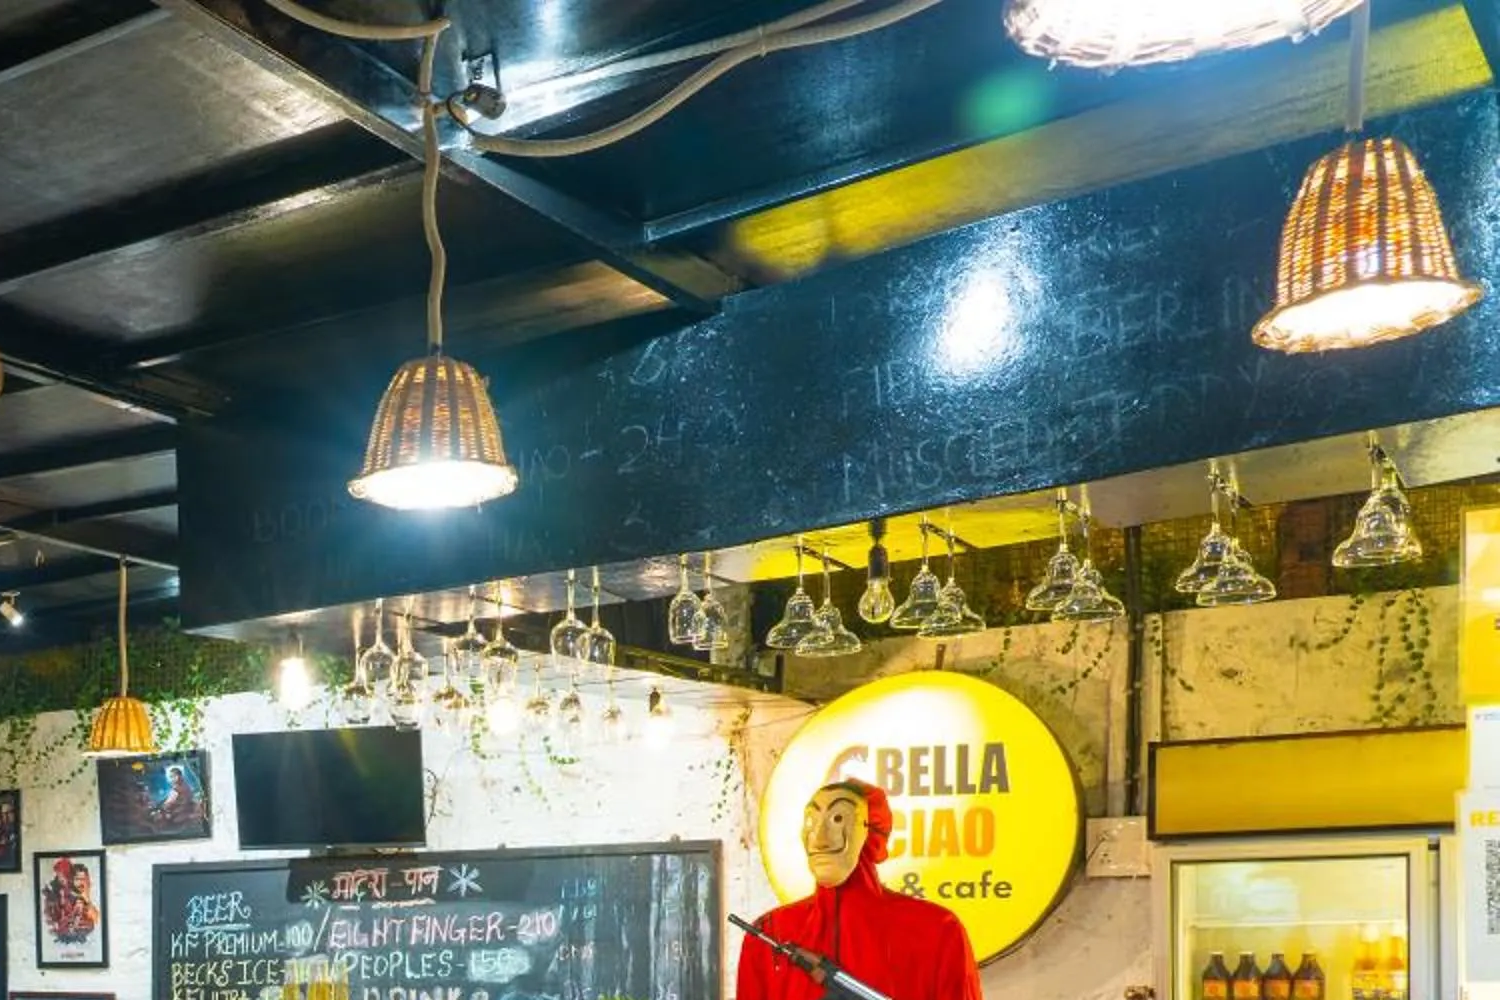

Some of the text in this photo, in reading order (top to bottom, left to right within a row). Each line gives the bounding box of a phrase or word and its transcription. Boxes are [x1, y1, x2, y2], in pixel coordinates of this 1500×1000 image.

[876, 741, 1010, 797] BELLA
[888, 806, 997, 859] CIAO
[902, 870, 1013, 899] & cafe
[187, 891, 251, 927] BEER
[171, 932, 200, 958] KF
[171, 959, 234, 988] BECKS
